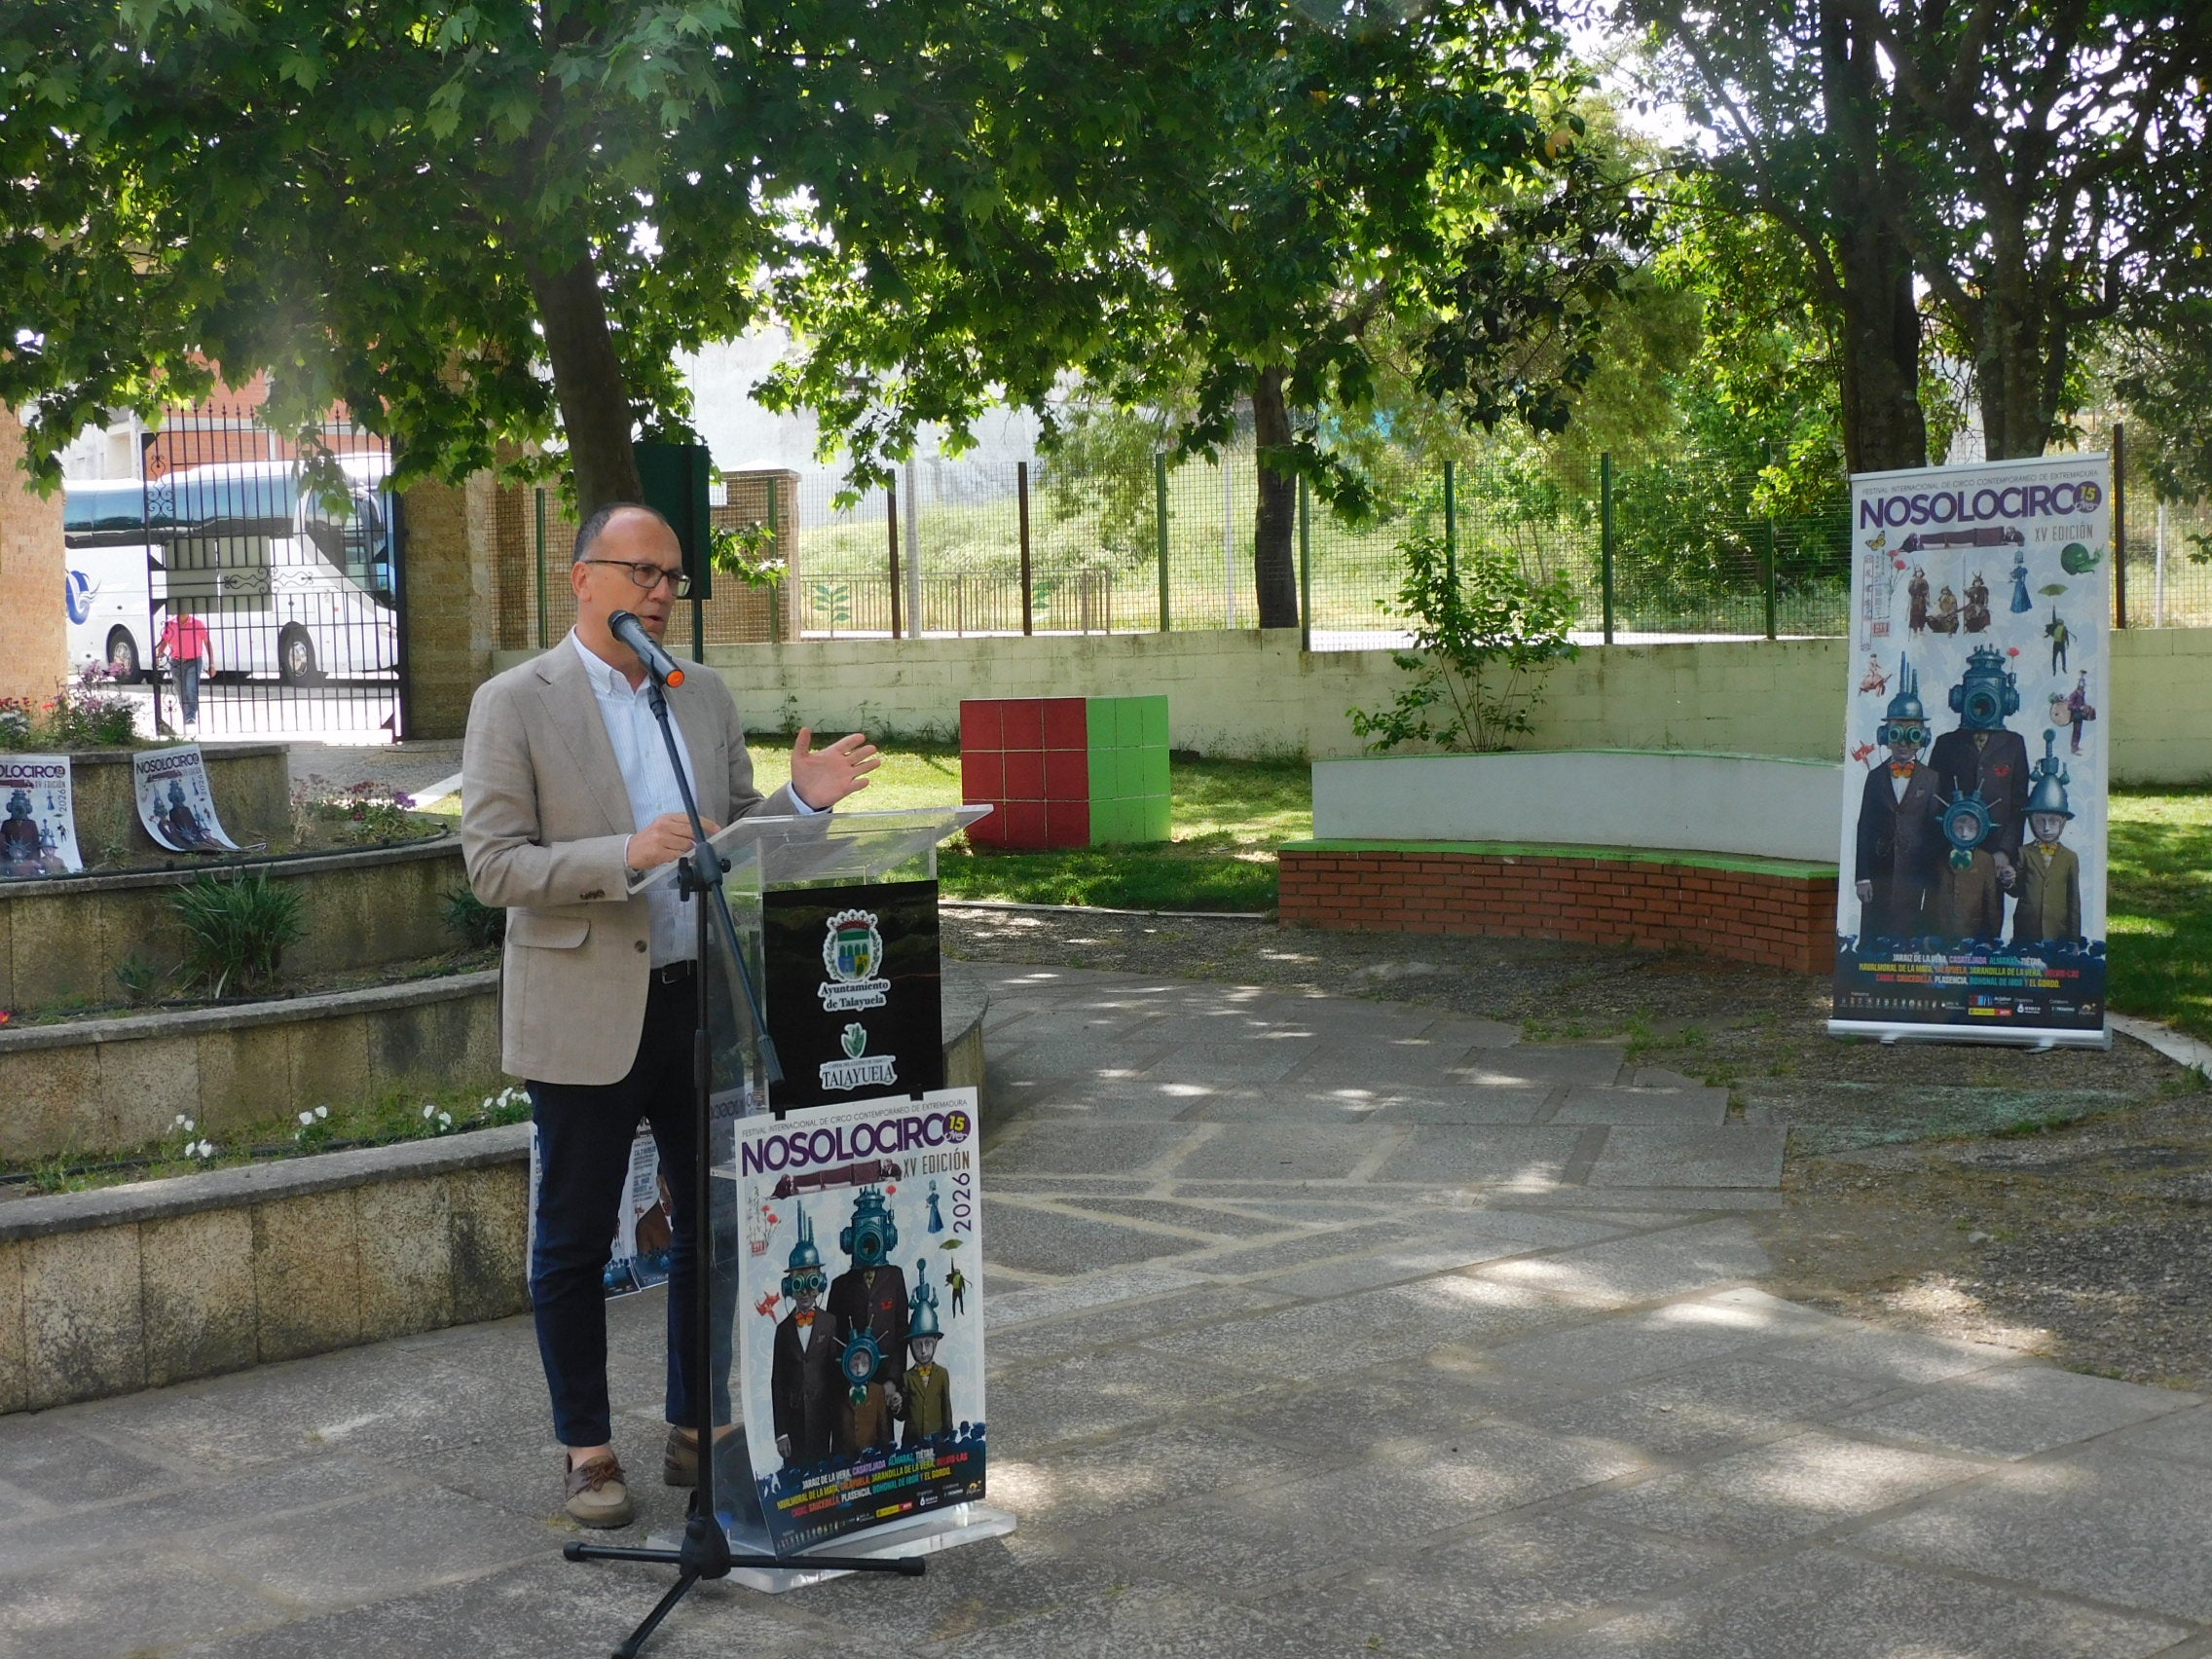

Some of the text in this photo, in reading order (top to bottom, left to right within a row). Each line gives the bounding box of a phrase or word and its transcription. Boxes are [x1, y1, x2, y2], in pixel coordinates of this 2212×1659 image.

[1891, 483, 1937, 492] INTERNACIONAL
[1953, 479, 1974, 488] CIRCO
[2050, 469, 2098, 480] EXTREMADURA
[2081, 486, 2096, 502] 15
[2035, 522, 2093, 542] XV EDICIÓN
[136, 753, 200, 775] NOSOLOCIRCO
[57, 789, 67, 812] 2026
[821, 981, 889, 998] Ayuntamiento
[2029, 978, 2037, 987] EL
[826, 994, 884, 1009] de Talayuela
[822, 1062, 894, 1088] TALAYUELA
[742, 1127, 766, 1137] FESTIVAL
[769, 1120, 817, 1131] INTERNACIONAL
[830, 1114, 852, 1124] CIRCO
[853, 1105, 910, 1121] CONTEMPORÁNEO
[911, 1104, 920, 1113] DE
[922, 1098, 968, 1111] EXTREMADURA
[949, 1115, 966, 1131] 15
[903, 1147, 971, 1179] XV EDICIÓN
[952, 1172, 972, 1234] 2026
[808, 1490, 817, 1500] DE
[817, 1487, 826, 1497] LA
[903, 1465, 911, 1475] DE
[911, 1463, 919, 1472] LA
[821, 1476, 829, 1486] DE
[828, 1472, 836, 1482] LA
[924, 1472, 931, 1481] EL
